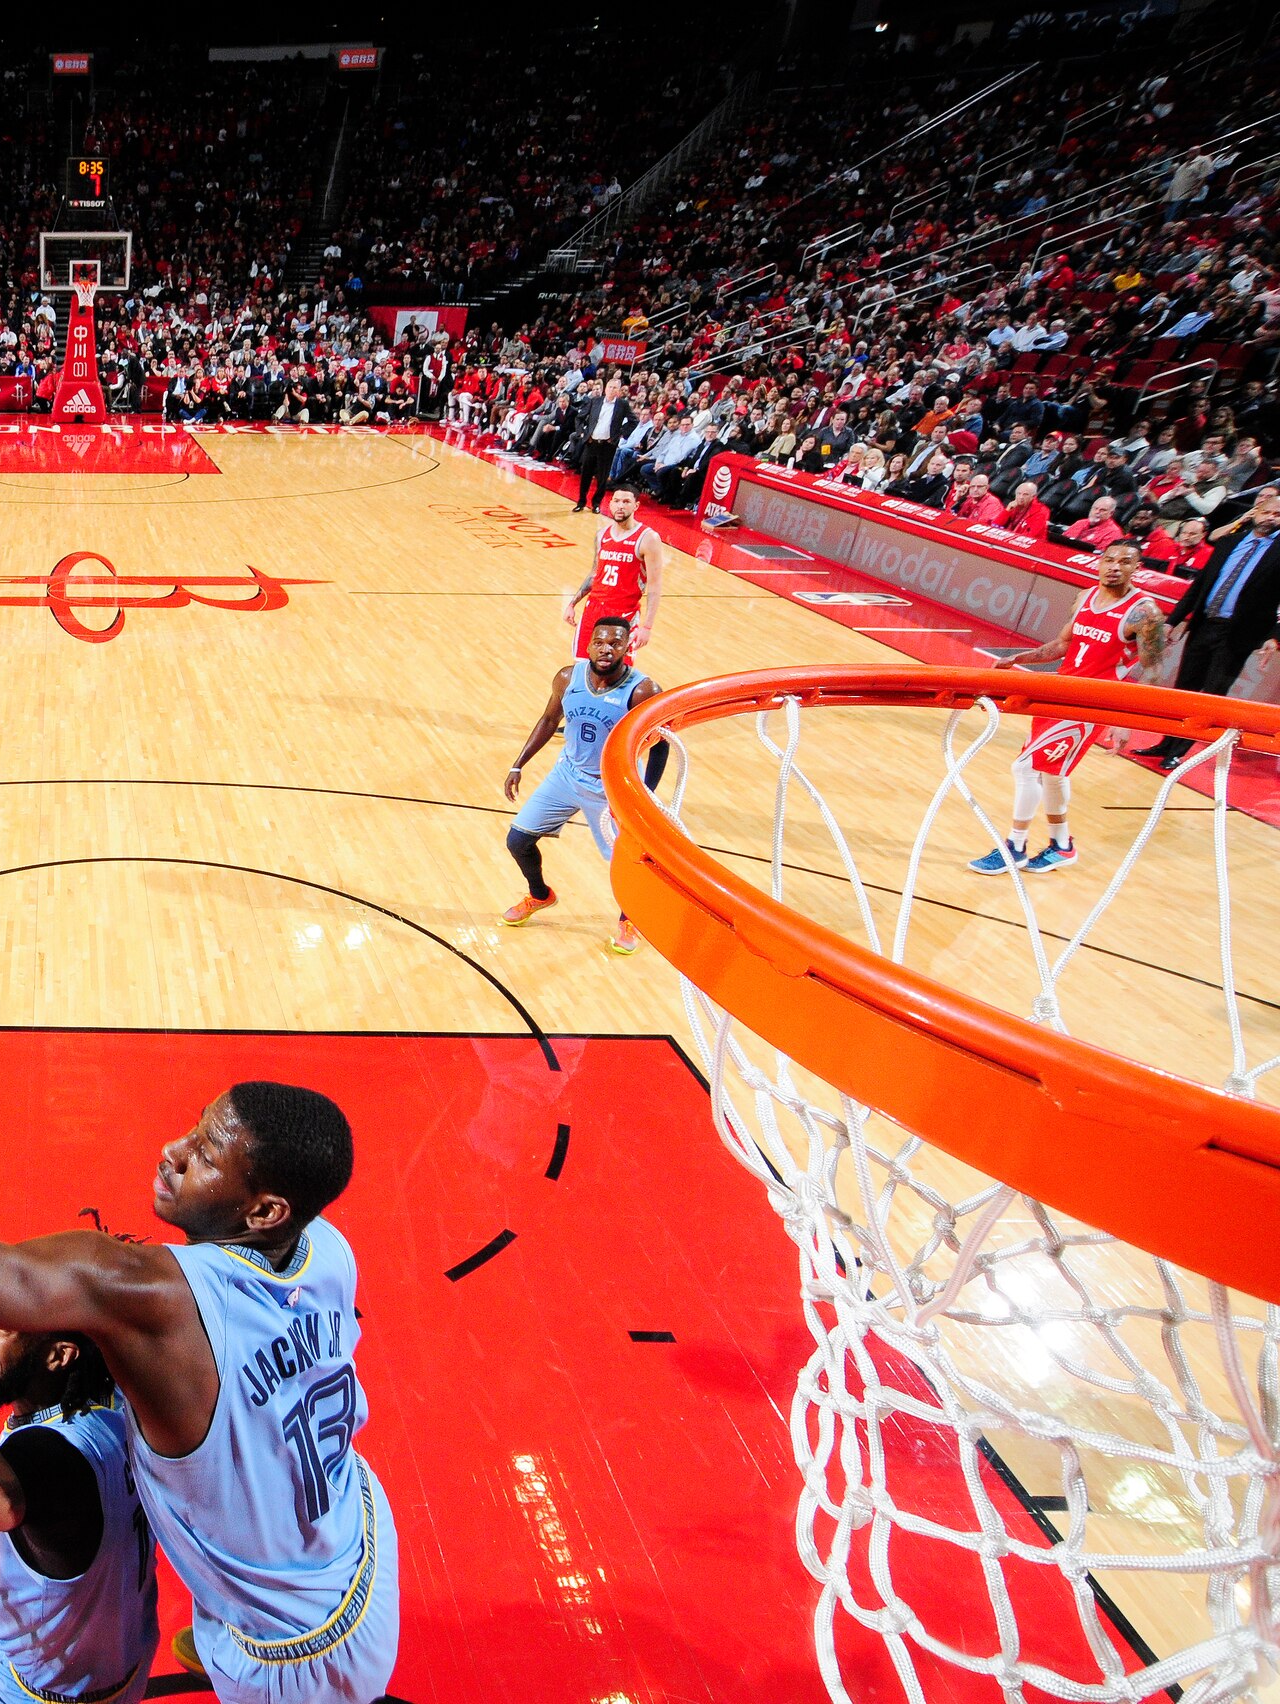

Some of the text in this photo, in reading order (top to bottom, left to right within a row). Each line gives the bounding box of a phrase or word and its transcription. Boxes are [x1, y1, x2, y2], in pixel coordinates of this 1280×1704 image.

[79, 161, 104, 175] 8:35
[90, 174, 101, 197] 7
[62, 404, 96, 413] adidas
[99, 423, 380, 434] ROCKETS
[428, 503, 523, 549] CENTER
[473, 505, 578, 549] TOYOTA
[600, 549, 634, 562] ROCKETS
[601, 564, 619, 586] 25
[835, 525, 1050, 632] niwodai.com
[1073, 621, 1112, 643] ROCKETS
[581, 722, 597, 743] 6
[282, 1363, 356, 1523] 13
